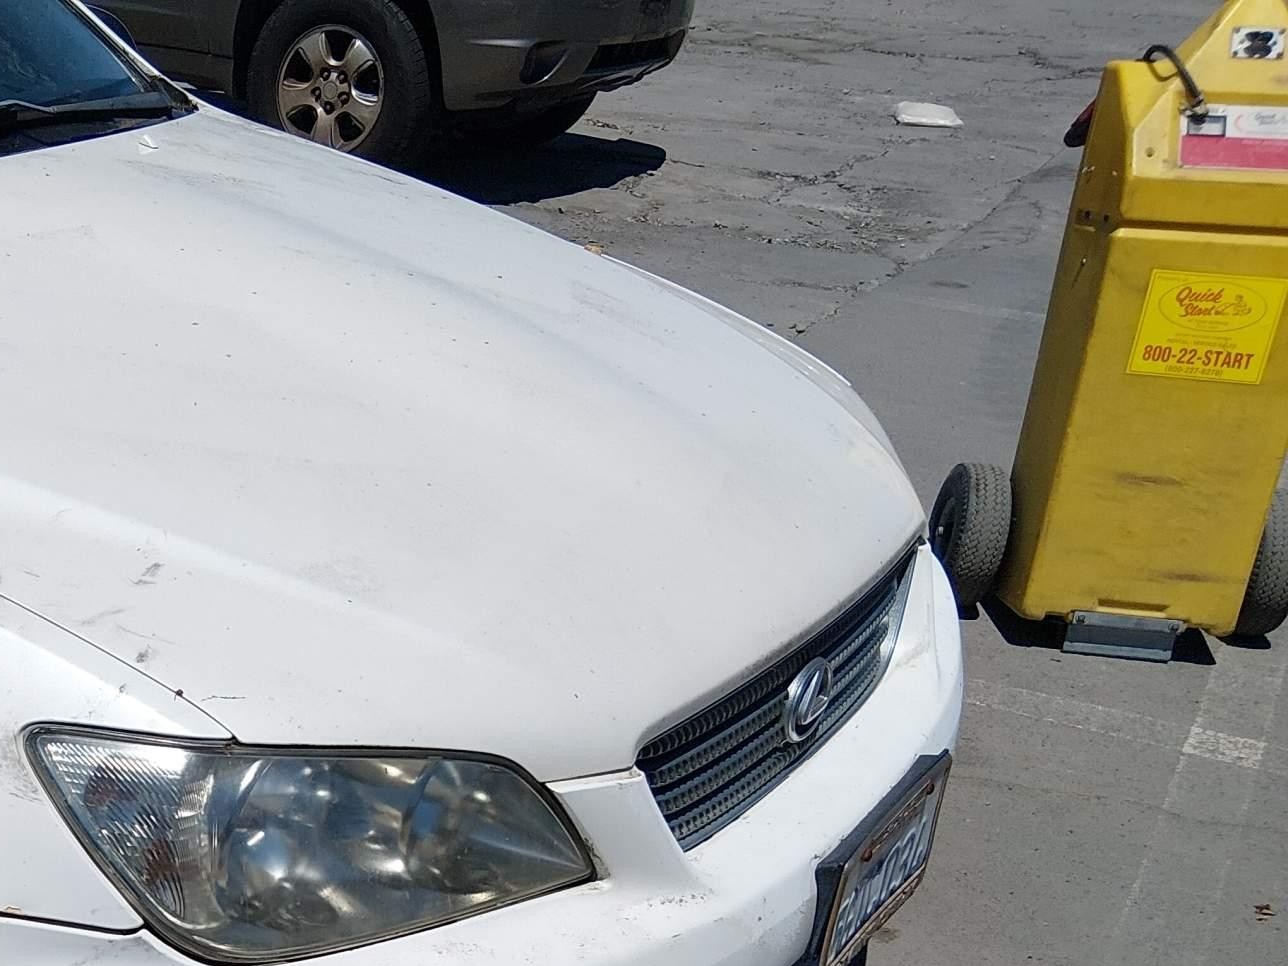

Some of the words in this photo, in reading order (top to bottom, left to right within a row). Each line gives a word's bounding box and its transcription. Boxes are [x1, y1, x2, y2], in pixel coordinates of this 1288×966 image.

[1176, 286, 1224, 306] Quick
[1179, 303, 1216, 317] Start
[1141, 345, 1255, 370] 800-22-START
